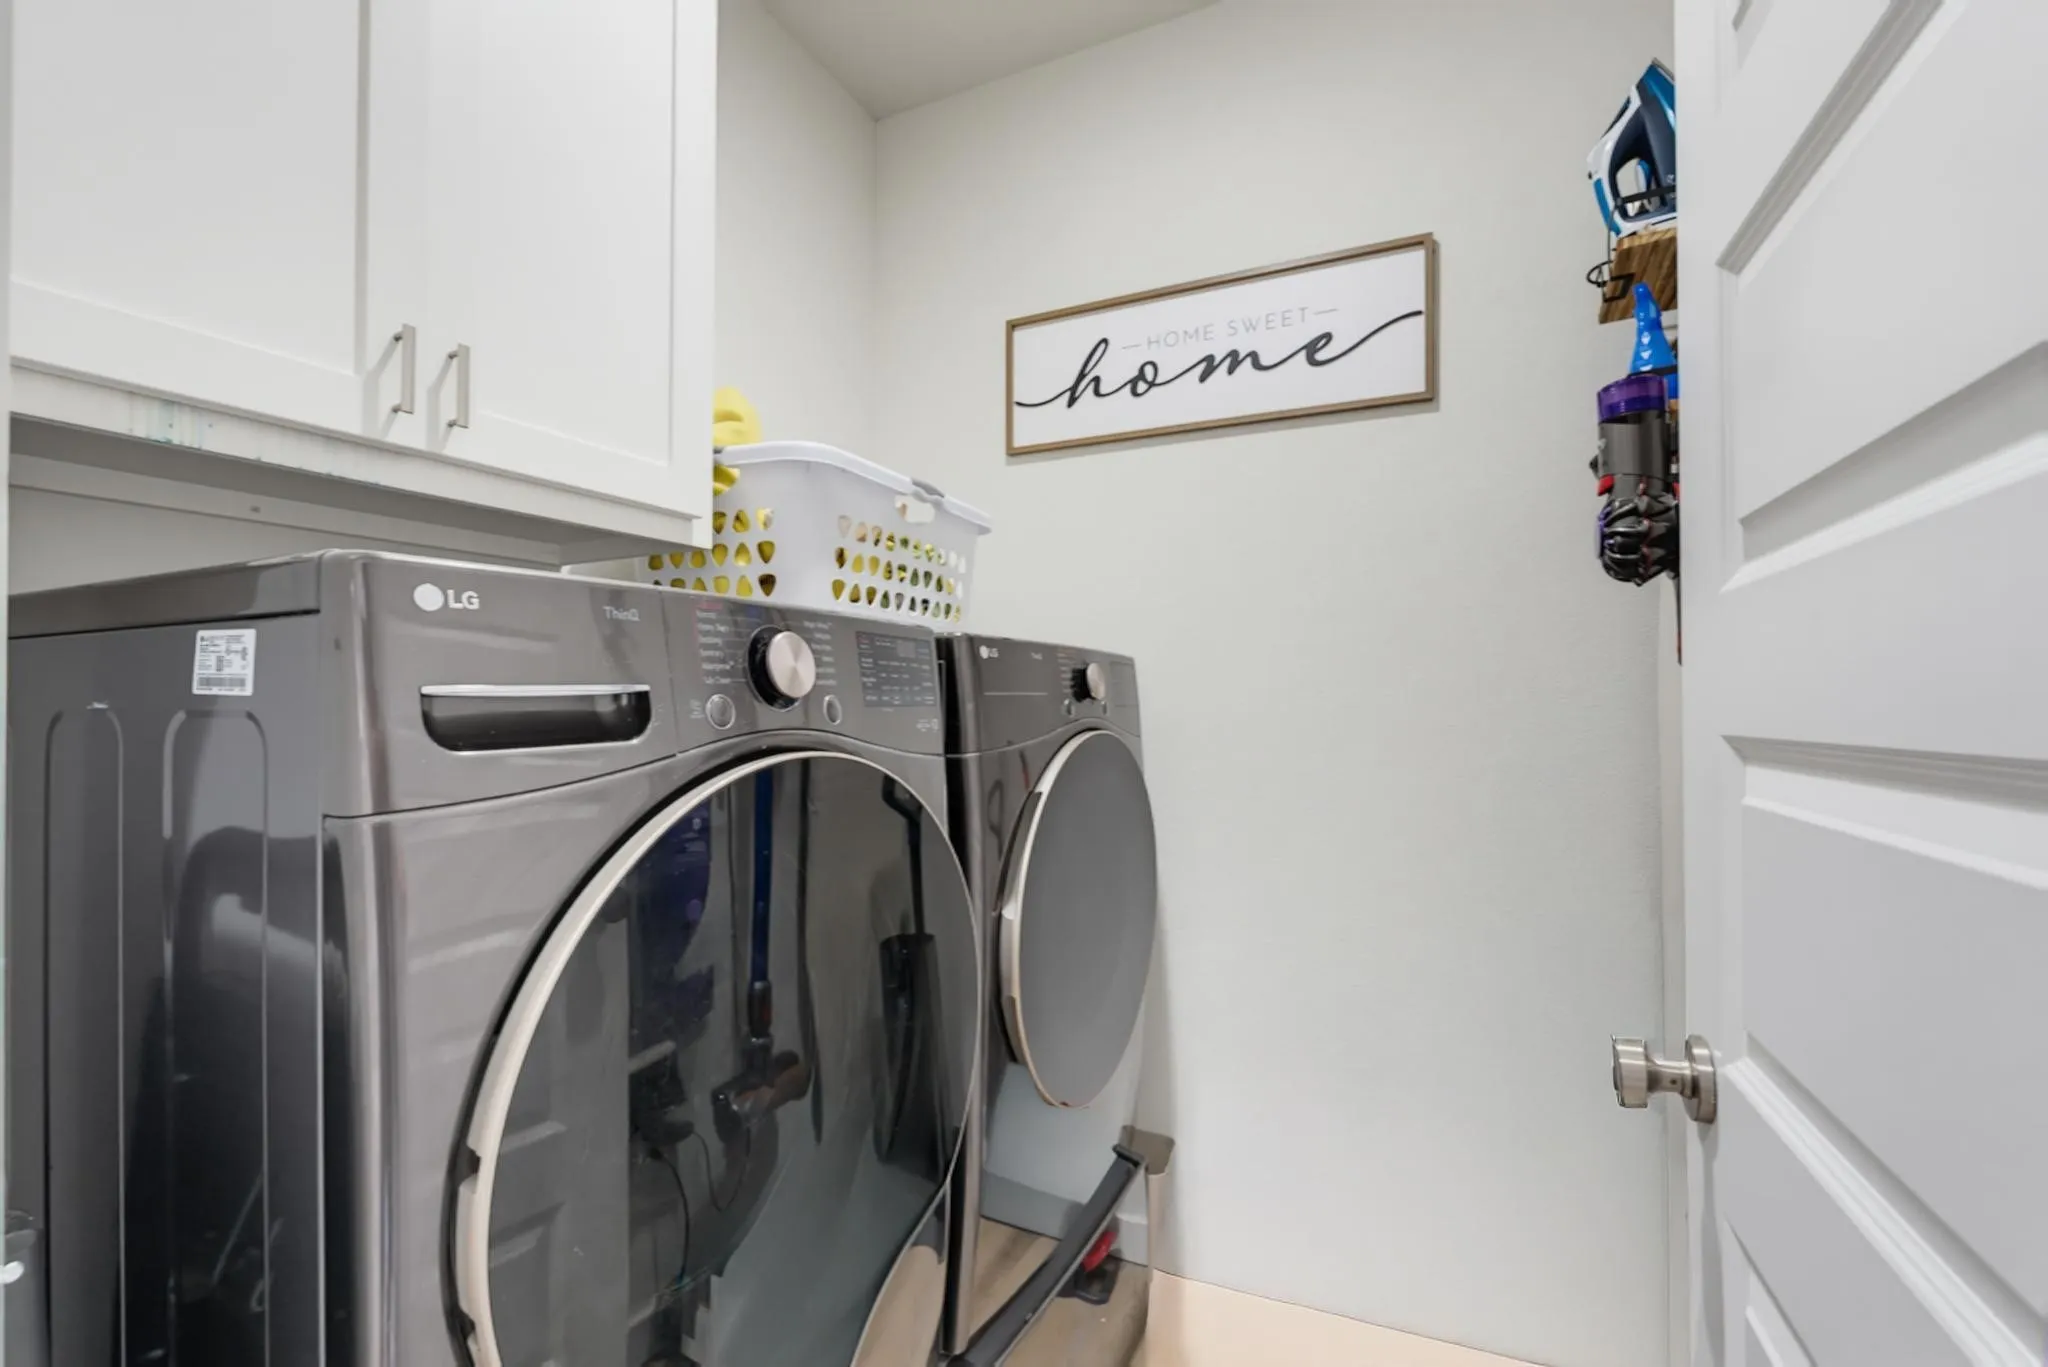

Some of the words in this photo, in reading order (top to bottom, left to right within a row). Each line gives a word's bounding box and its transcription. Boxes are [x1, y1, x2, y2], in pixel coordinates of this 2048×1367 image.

[1145, 323, 1215, 351] HOME
[1227, 306, 1310, 336] SWEET
[1014, 309, 1424, 409] home
[446, 588, 480, 610] LG
